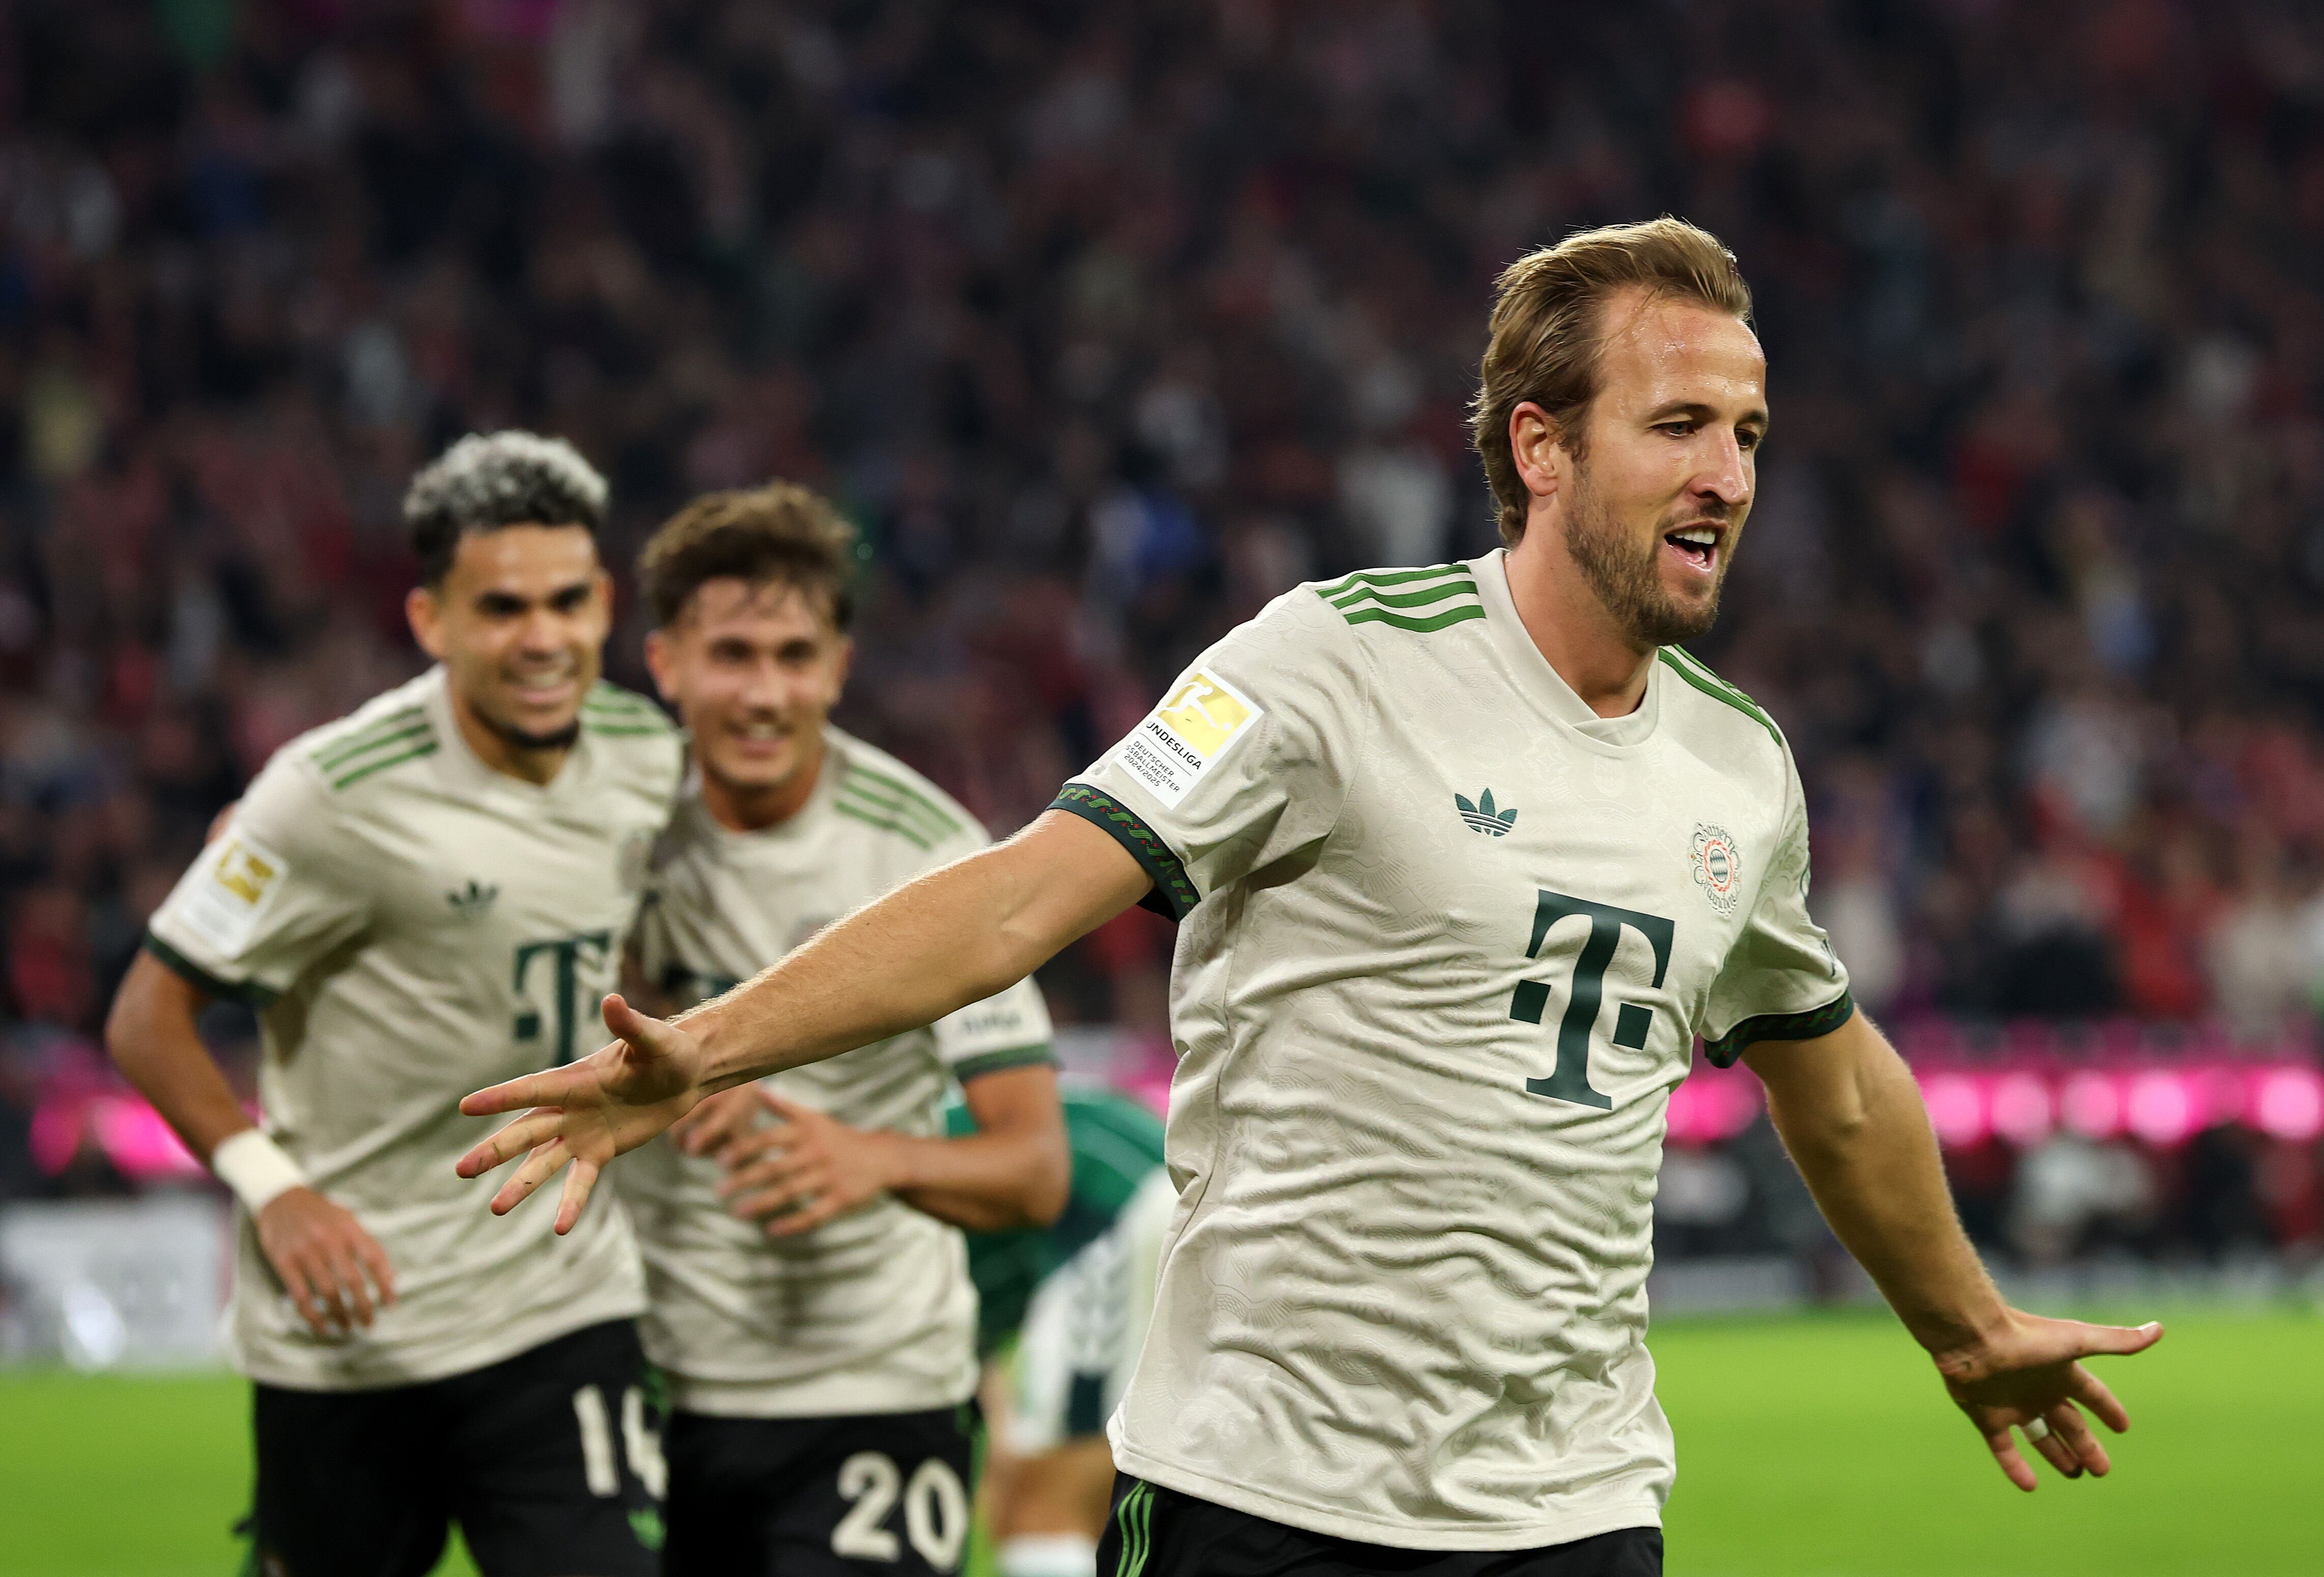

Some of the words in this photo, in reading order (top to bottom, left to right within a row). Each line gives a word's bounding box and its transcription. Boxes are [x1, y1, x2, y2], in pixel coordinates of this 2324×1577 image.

[1125, 745, 1180, 792] SSBALLMEISTER
[1134, 741, 1174, 778] DEUTSCHER
[1146, 721, 1202, 770] UNDESLIGA
[1124, 754, 1161, 787] 2024/2025
[514, 928, 611, 1068] T
[1524, 889, 1675, 1111] T
[830, 1451, 968, 1574] 20
